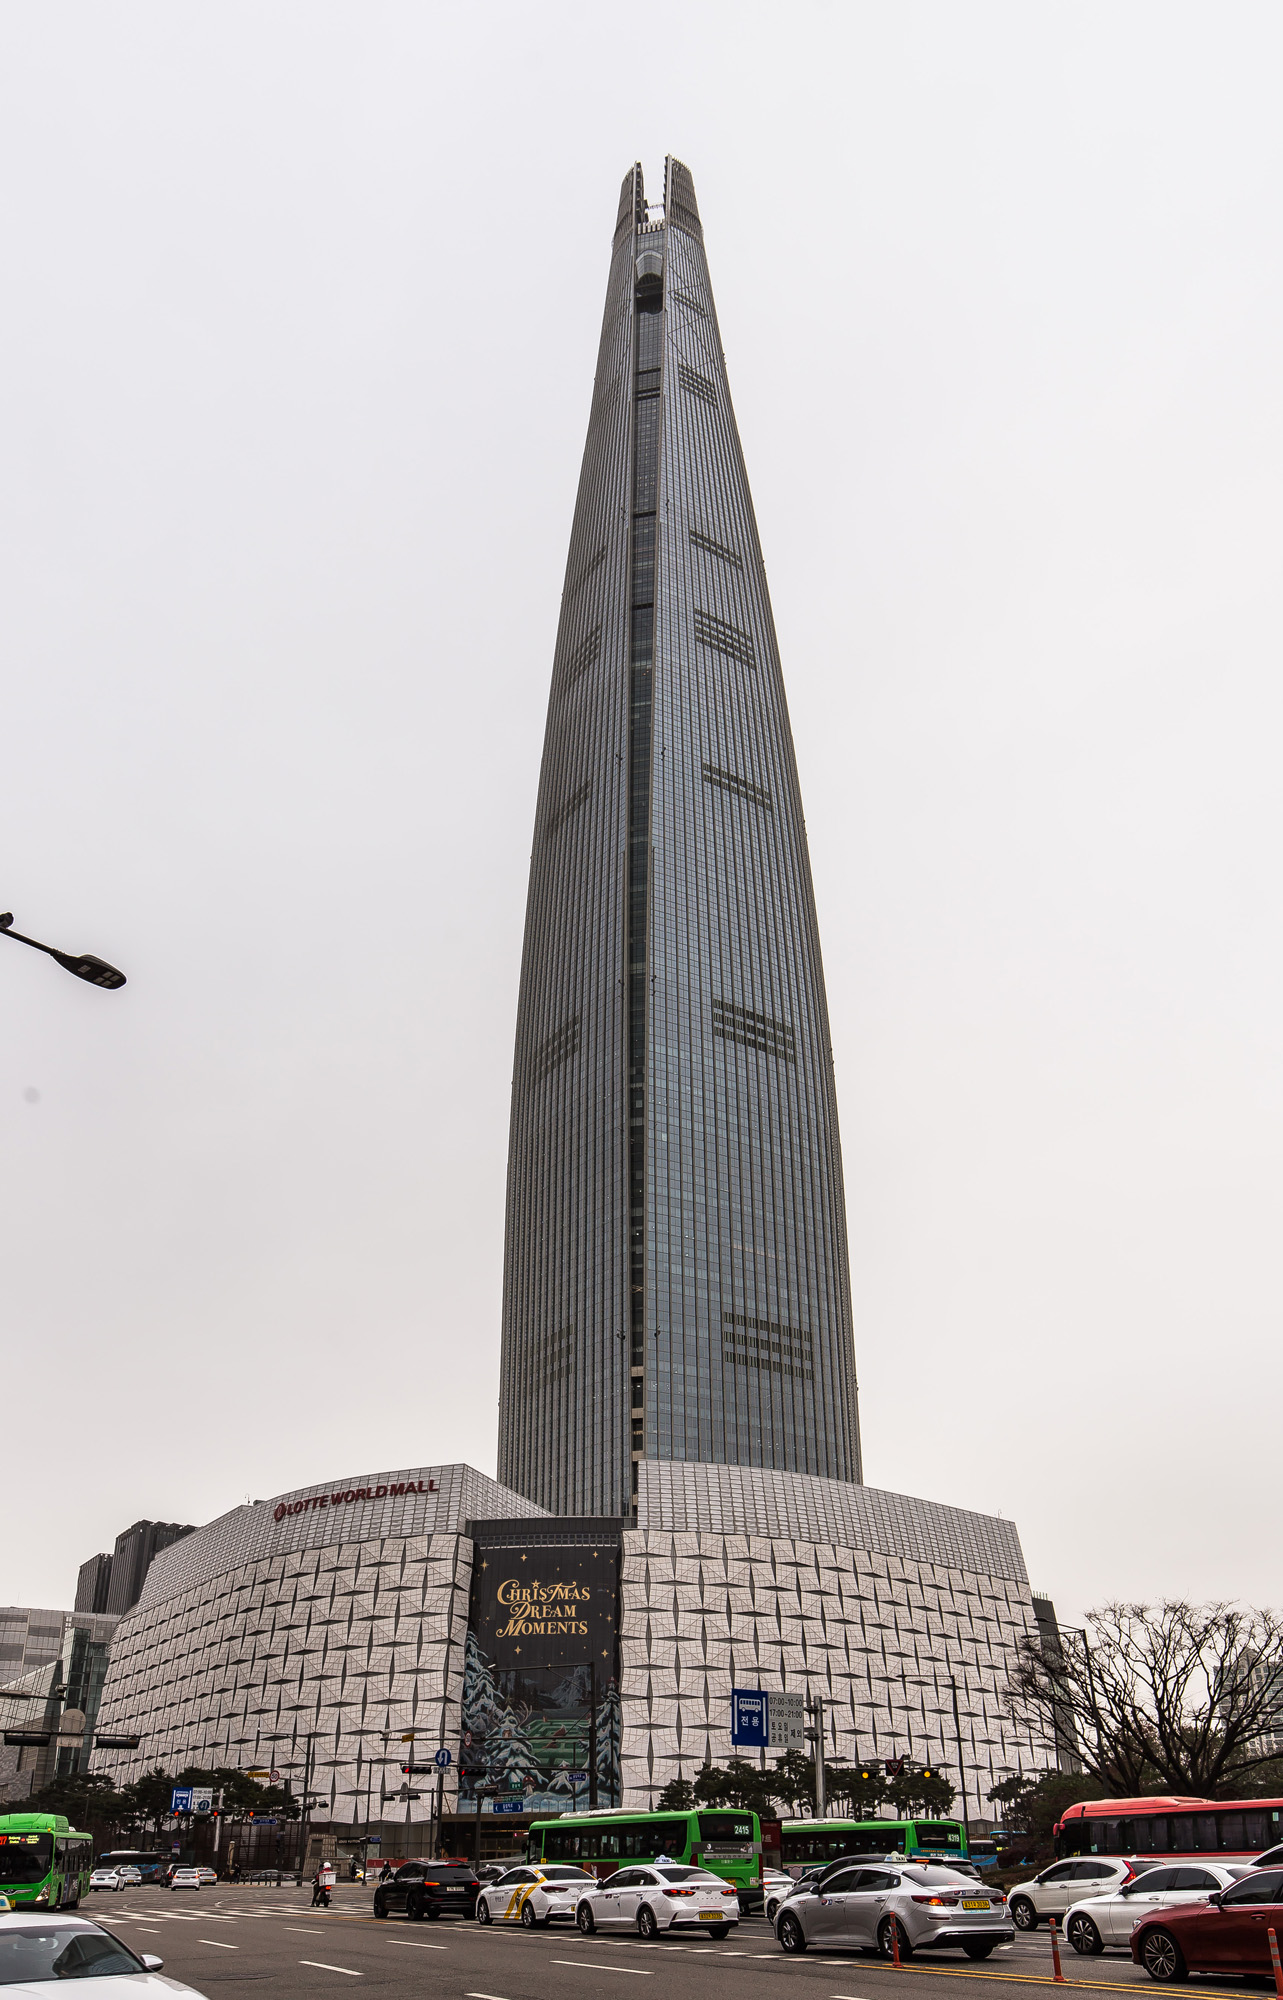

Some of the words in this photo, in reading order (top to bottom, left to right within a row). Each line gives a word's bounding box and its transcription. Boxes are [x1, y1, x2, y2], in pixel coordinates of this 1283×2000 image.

[286, 1495, 330, 1516] LOTTE
[331, 1485, 388, 1506] WORLD
[390, 1479, 439, 1497] MALL
[510, 1601, 576, 1619] DREAM
[496, 1619, 588, 1637] MOMENTS
[734, 1825, 750, 1835] 2415
[948, 1833, 960, 1842] 4319
